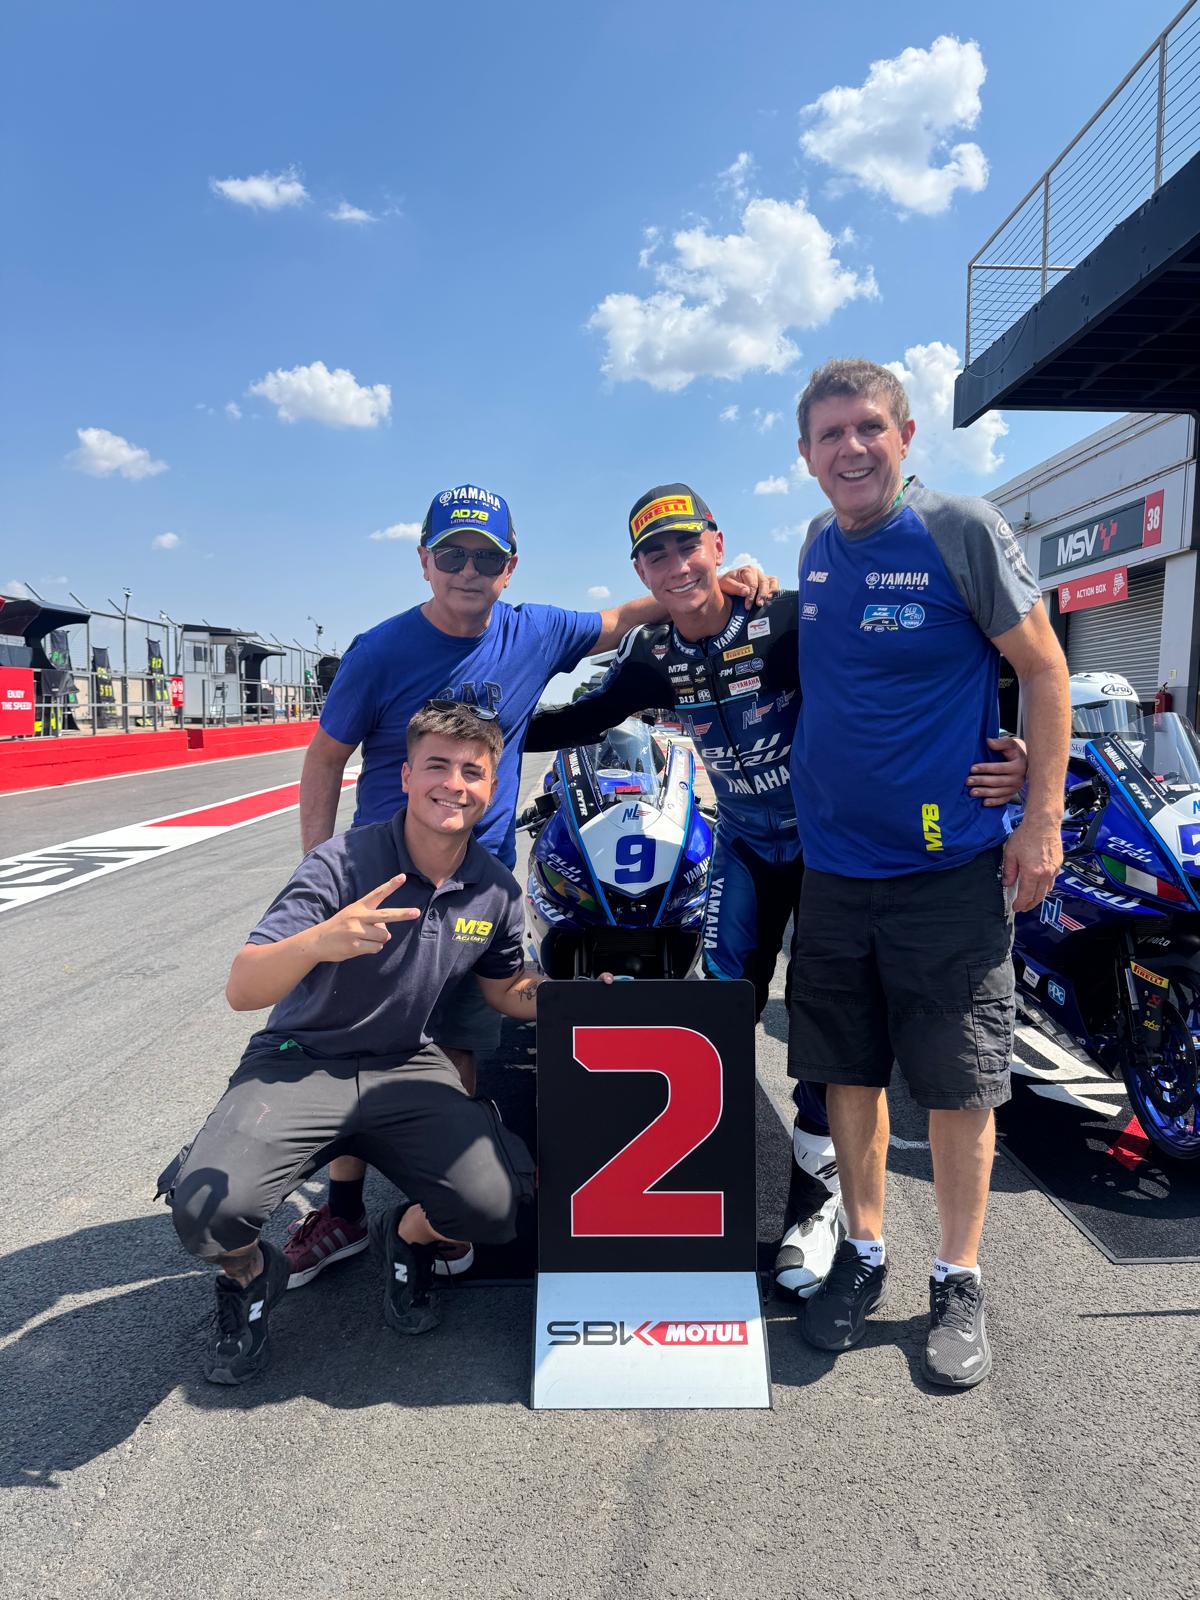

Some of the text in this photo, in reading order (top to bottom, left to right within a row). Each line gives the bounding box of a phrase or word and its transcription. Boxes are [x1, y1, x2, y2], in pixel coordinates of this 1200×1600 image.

[453, 487, 501, 509] YAMAHA
[634, 499, 688, 532] PIRELLI
[1146, 506, 1161, 531] 38
[1057, 525, 1099, 566] MSV
[881, 572, 929, 586] YAMAHA
[1076, 583, 1107, 599] ACTION BOX
[714, 615, 745, 650] YAMAHA
[668, 663, 689, 674] M78
[719, 668, 733, 677] FIM
[737, 677, 760, 689] YAMAHA
[922, 803, 944, 851] M78
[1106, 843, 1152, 863] CRU
[1108, 837, 1152, 855] BLU
[548, 853, 582, 874] BLU
[615, 834, 656, 884] 9
[547, 860, 581, 882] CRU
[704, 877, 725, 949] YAMAHA
[1133, 964, 1165, 986] PIRELLI
[571, 1026, 724, 1237] 2
[665, 1323, 745, 1343] MOTUL
